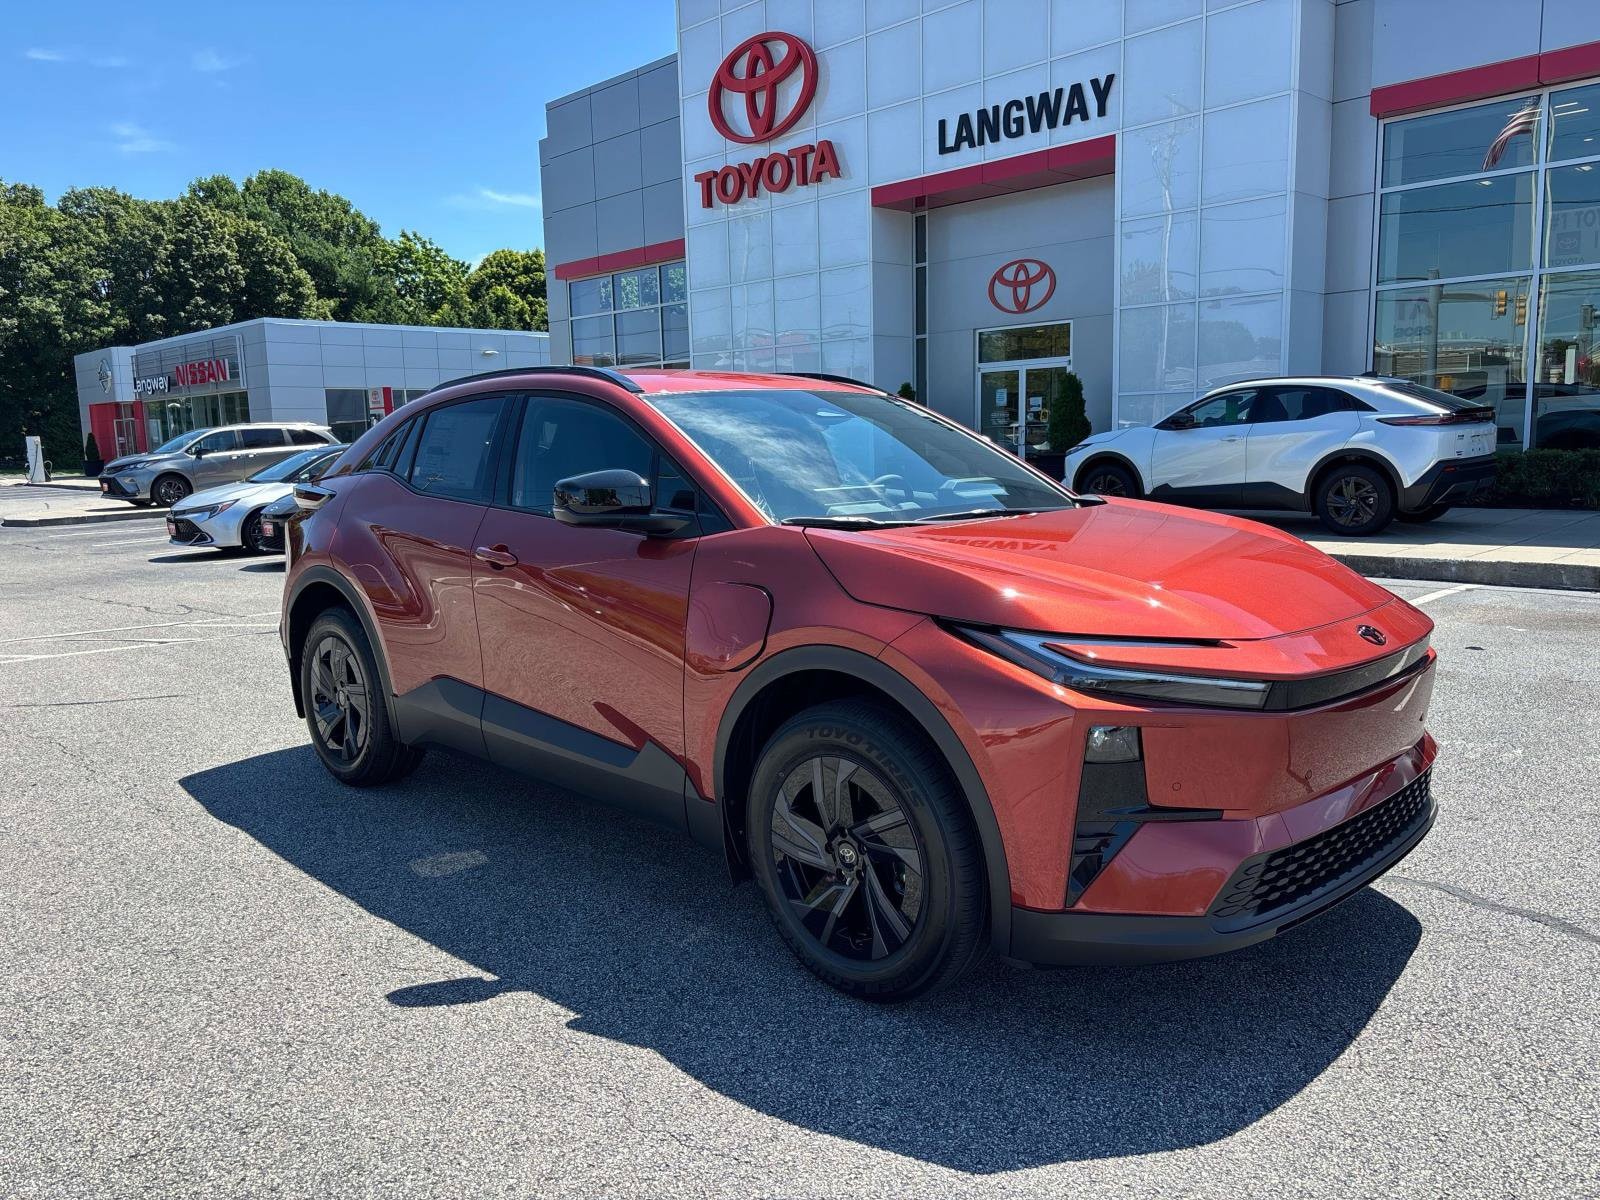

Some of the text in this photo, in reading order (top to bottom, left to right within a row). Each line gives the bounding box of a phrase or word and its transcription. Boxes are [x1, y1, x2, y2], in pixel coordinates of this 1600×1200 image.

[938, 73, 1115, 155] LANGWAY
[694, 139, 841, 208] TOYOTA
[133, 375, 170, 395] Langway
[175, 358, 230, 386] NISSAN
[806, 726, 926, 808] TOYO TIRES
